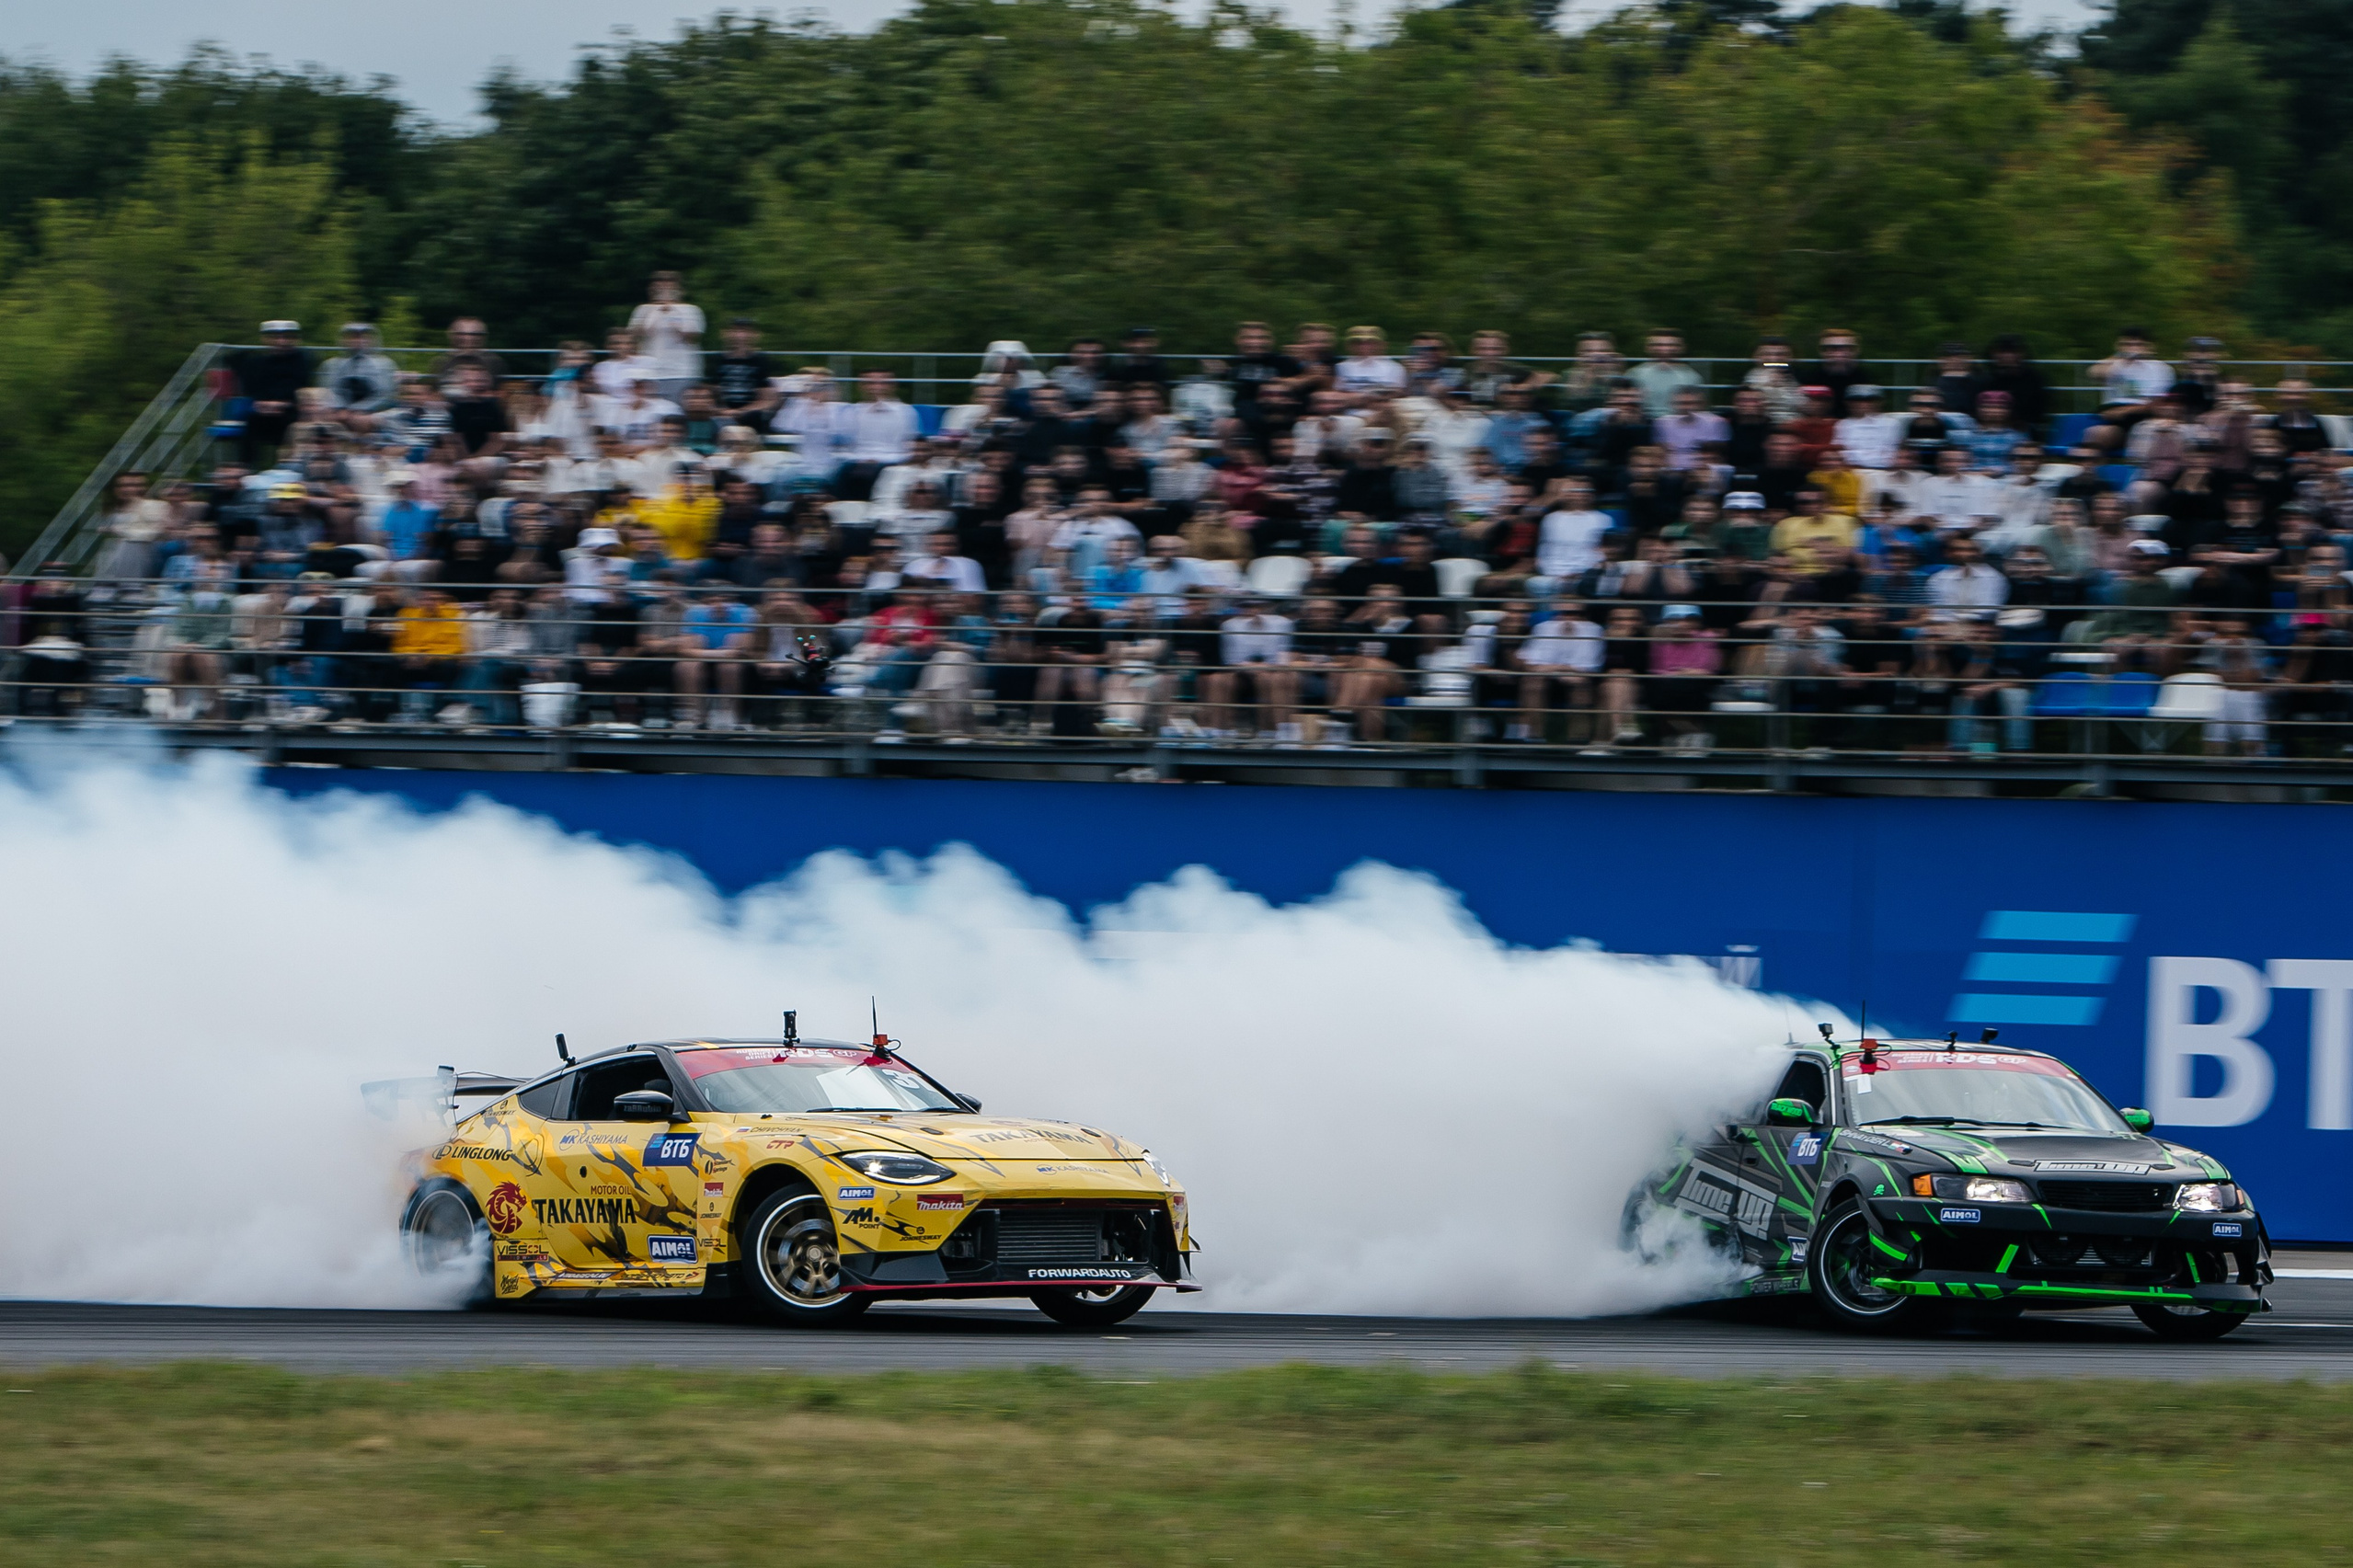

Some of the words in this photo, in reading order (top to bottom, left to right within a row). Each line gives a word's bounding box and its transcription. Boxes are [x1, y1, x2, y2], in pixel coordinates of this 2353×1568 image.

[577, 1134, 628, 1144] KASHIYAMA
[969, 1128, 1095, 1145] TAKAYAMA
[660, 1139, 693, 1159] ВТБ
[1797, 1138, 1821, 1157] ВТБ
[451, 1146, 512, 1162] LINGLONG
[591, 1185, 617, 1195] MOTOR
[618, 1185, 632, 1195] OIL
[840, 1189, 874, 1197] AIMOL
[532, 1197, 637, 1224] TAKAYAMA
[1943, 1210, 1978, 1219] AIMOL
[2214, 1225, 2240, 1234] AIMOL
[497, 1244, 549, 1255] VISSOL
[651, 1242, 694, 1257] AIMOL
[1028, 1269, 1131, 1278] FORWARDAUTO
